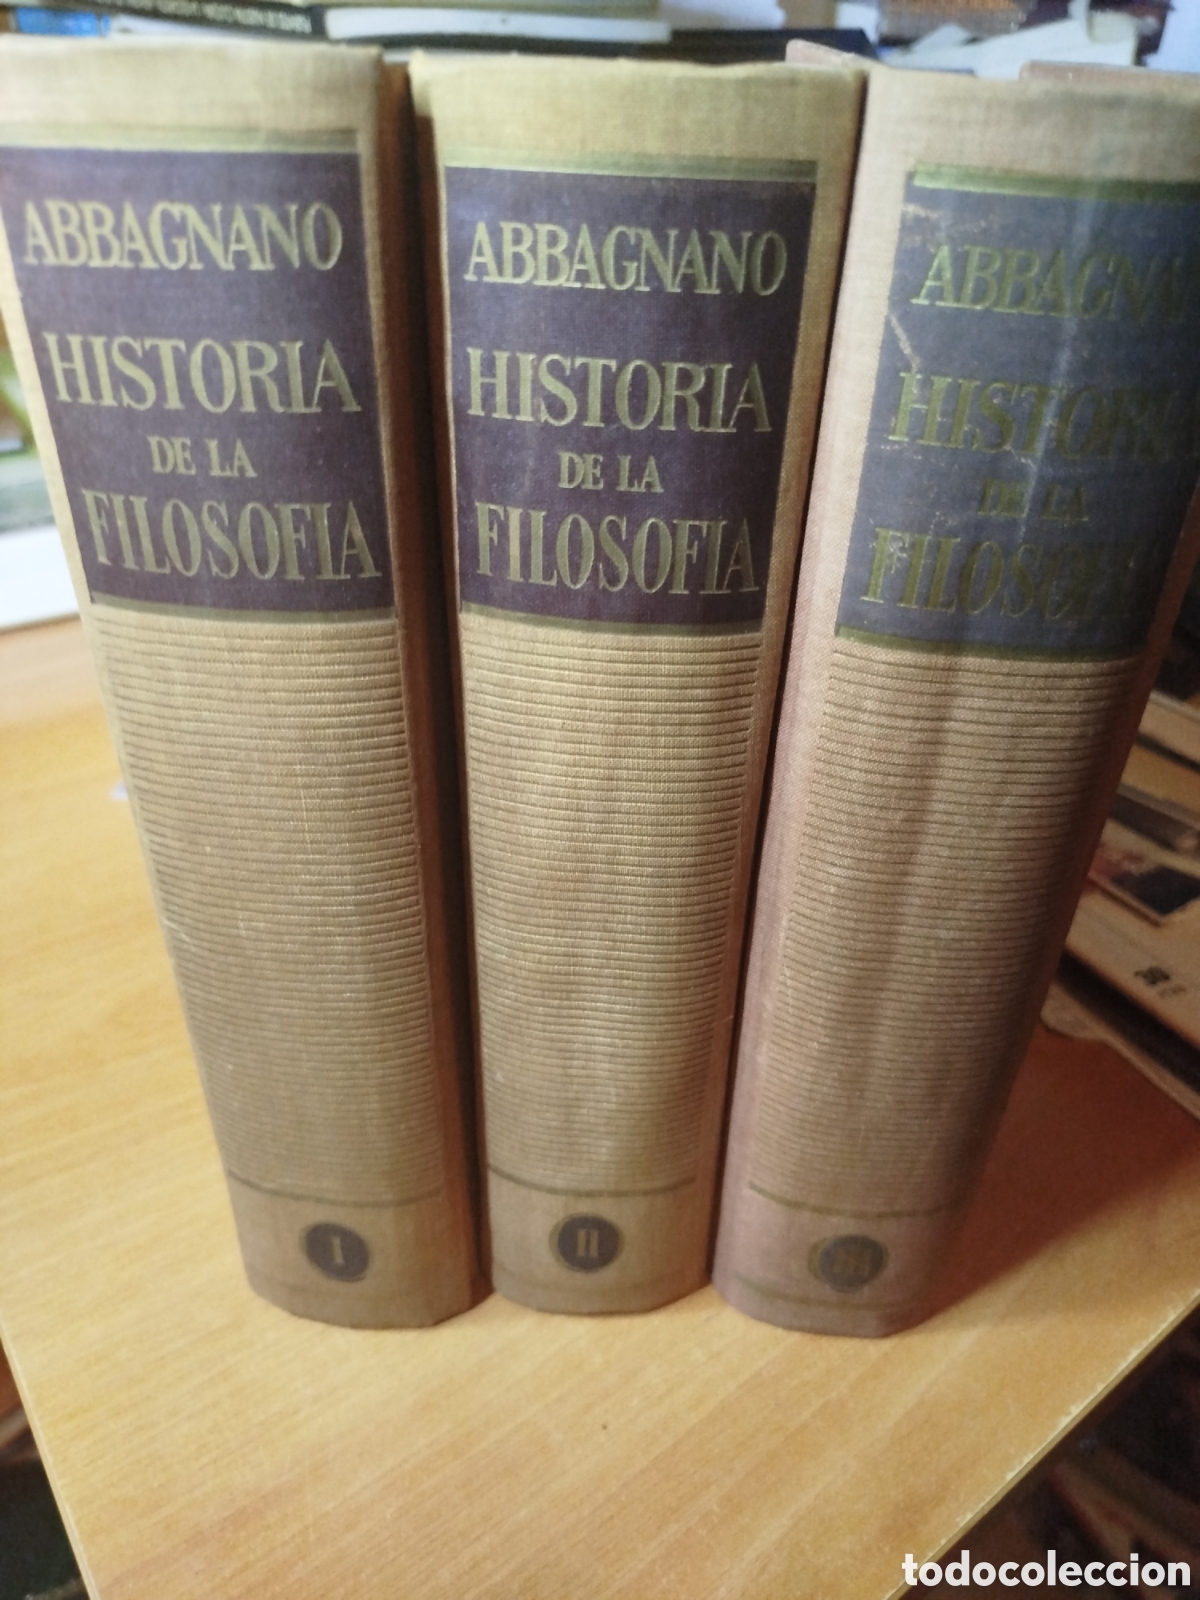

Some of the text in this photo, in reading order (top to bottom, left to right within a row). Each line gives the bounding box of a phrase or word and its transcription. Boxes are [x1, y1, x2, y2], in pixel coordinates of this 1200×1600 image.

[23, 199, 343, 271] ABBAGNANO
[463, 220, 788, 296] ABBAGNANO
[910, 241, 1200, 322] ABBAGN
[43, 332, 362, 414] HISTORIA
[466, 346, 772, 434] HISTORIA
[147, 435, 258, 478] DE LA
[557, 450, 664, 493] DE LA
[82, 489, 383, 580] FILOSOFIA
[475, 500, 760, 596] FILOSOFIA
[861, 526, 1145, 626] FILOSO
[575, 1228, 600, 1258] II
